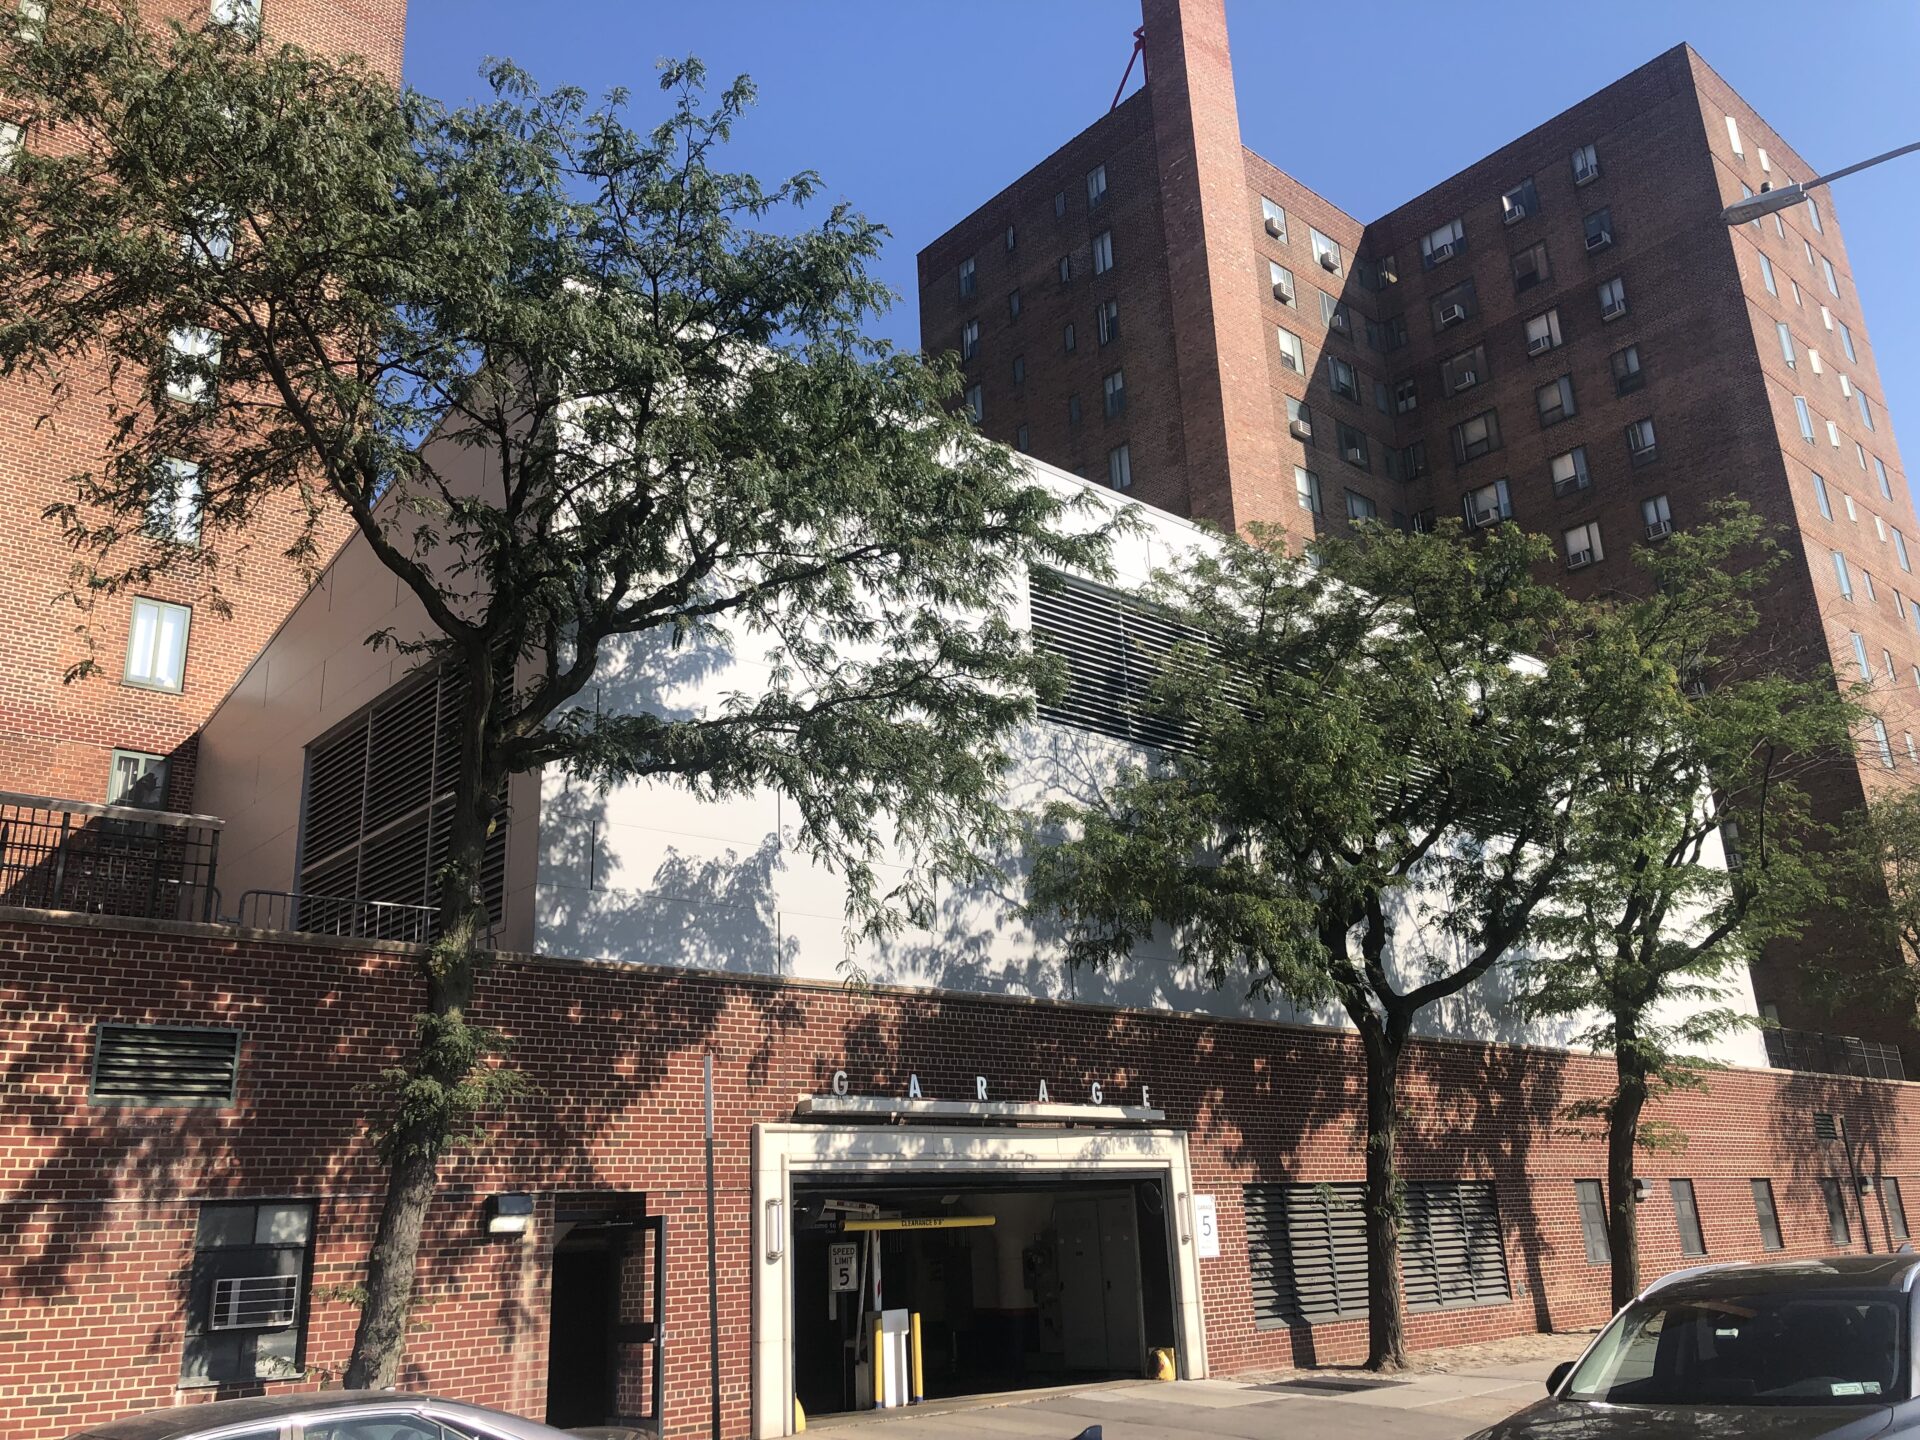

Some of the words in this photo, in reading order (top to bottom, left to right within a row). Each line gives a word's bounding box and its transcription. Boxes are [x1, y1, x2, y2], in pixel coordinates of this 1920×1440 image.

[833, 1070, 1150, 1107] GARAGE
[901, 1218, 932, 1227] CLEARANCE
[1202, 1215, 1211, 1236] 5
[832, 1247, 855, 1256] SPEED
[834, 1256, 853, 1265] LIMIT
[839, 1267, 850, 1286] 5
